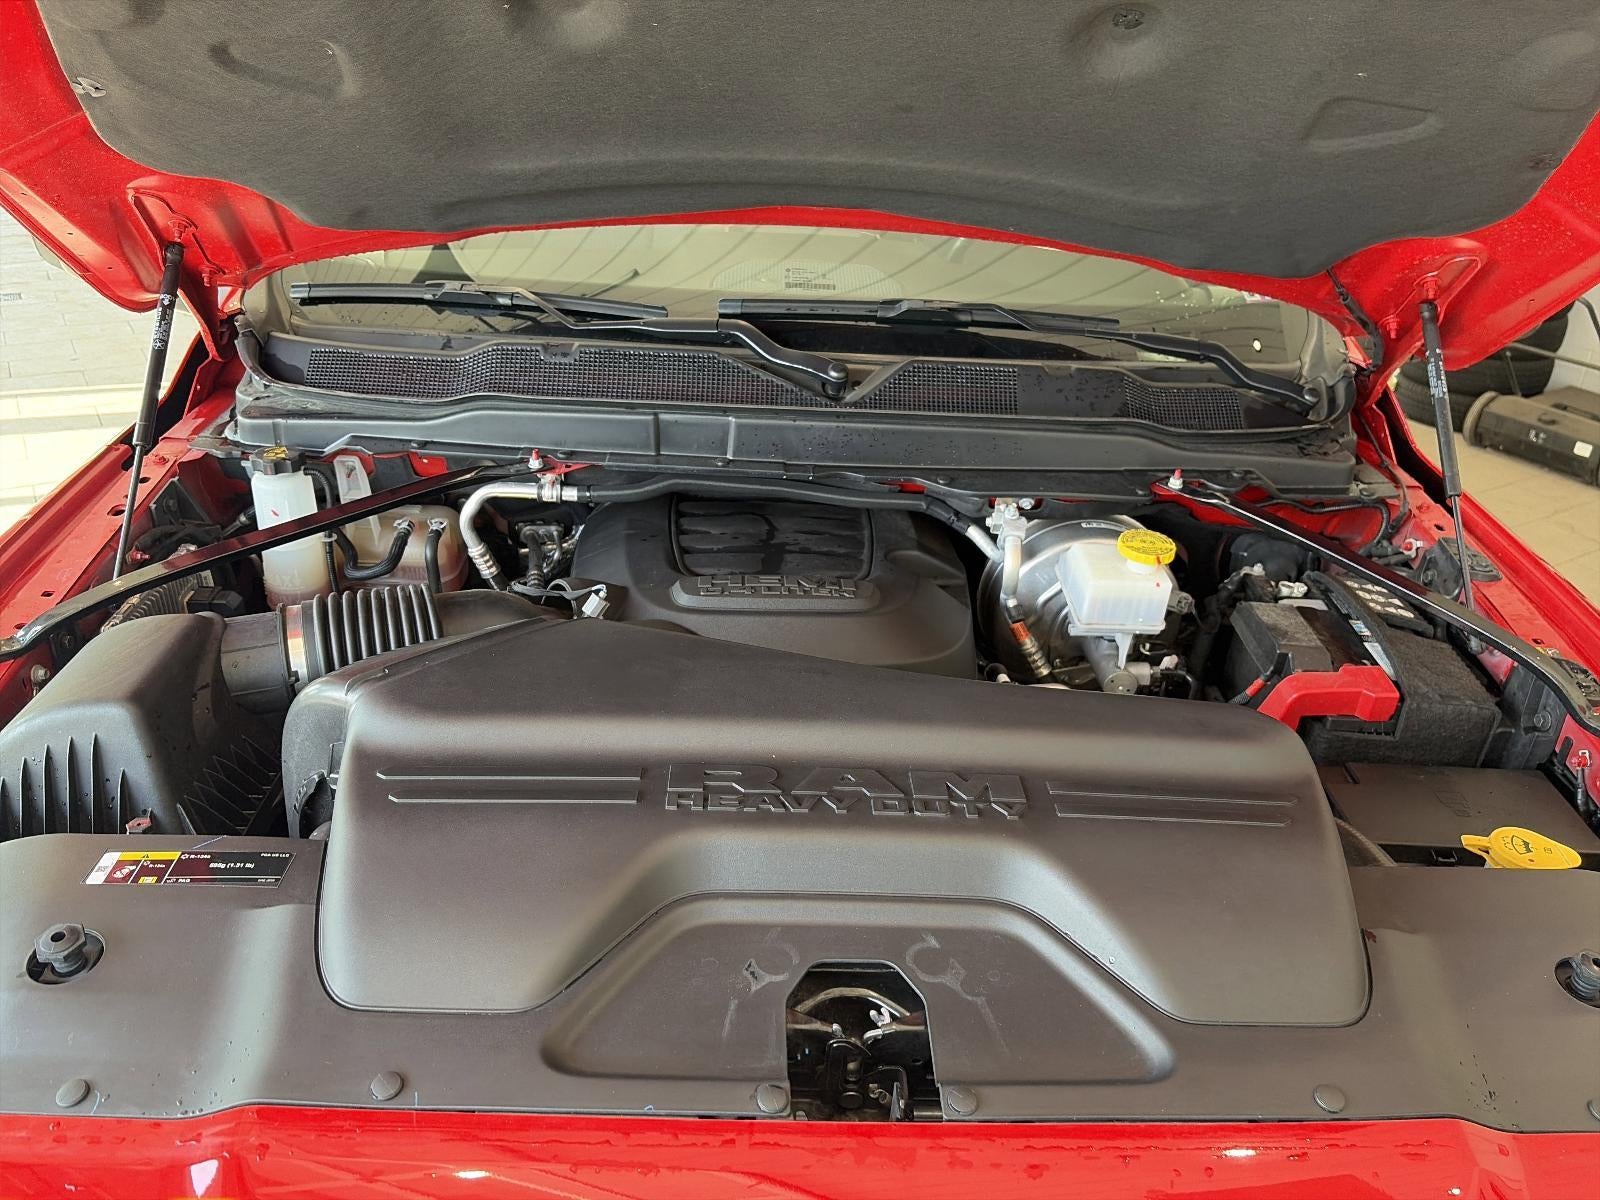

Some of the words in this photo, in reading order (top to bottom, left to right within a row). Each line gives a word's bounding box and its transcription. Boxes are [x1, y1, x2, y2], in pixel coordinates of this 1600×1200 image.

[667, 763, 1026, 803] RAM
[665, 791, 860, 813] HEAVY
[871, 798, 1026, 820] DUTY
